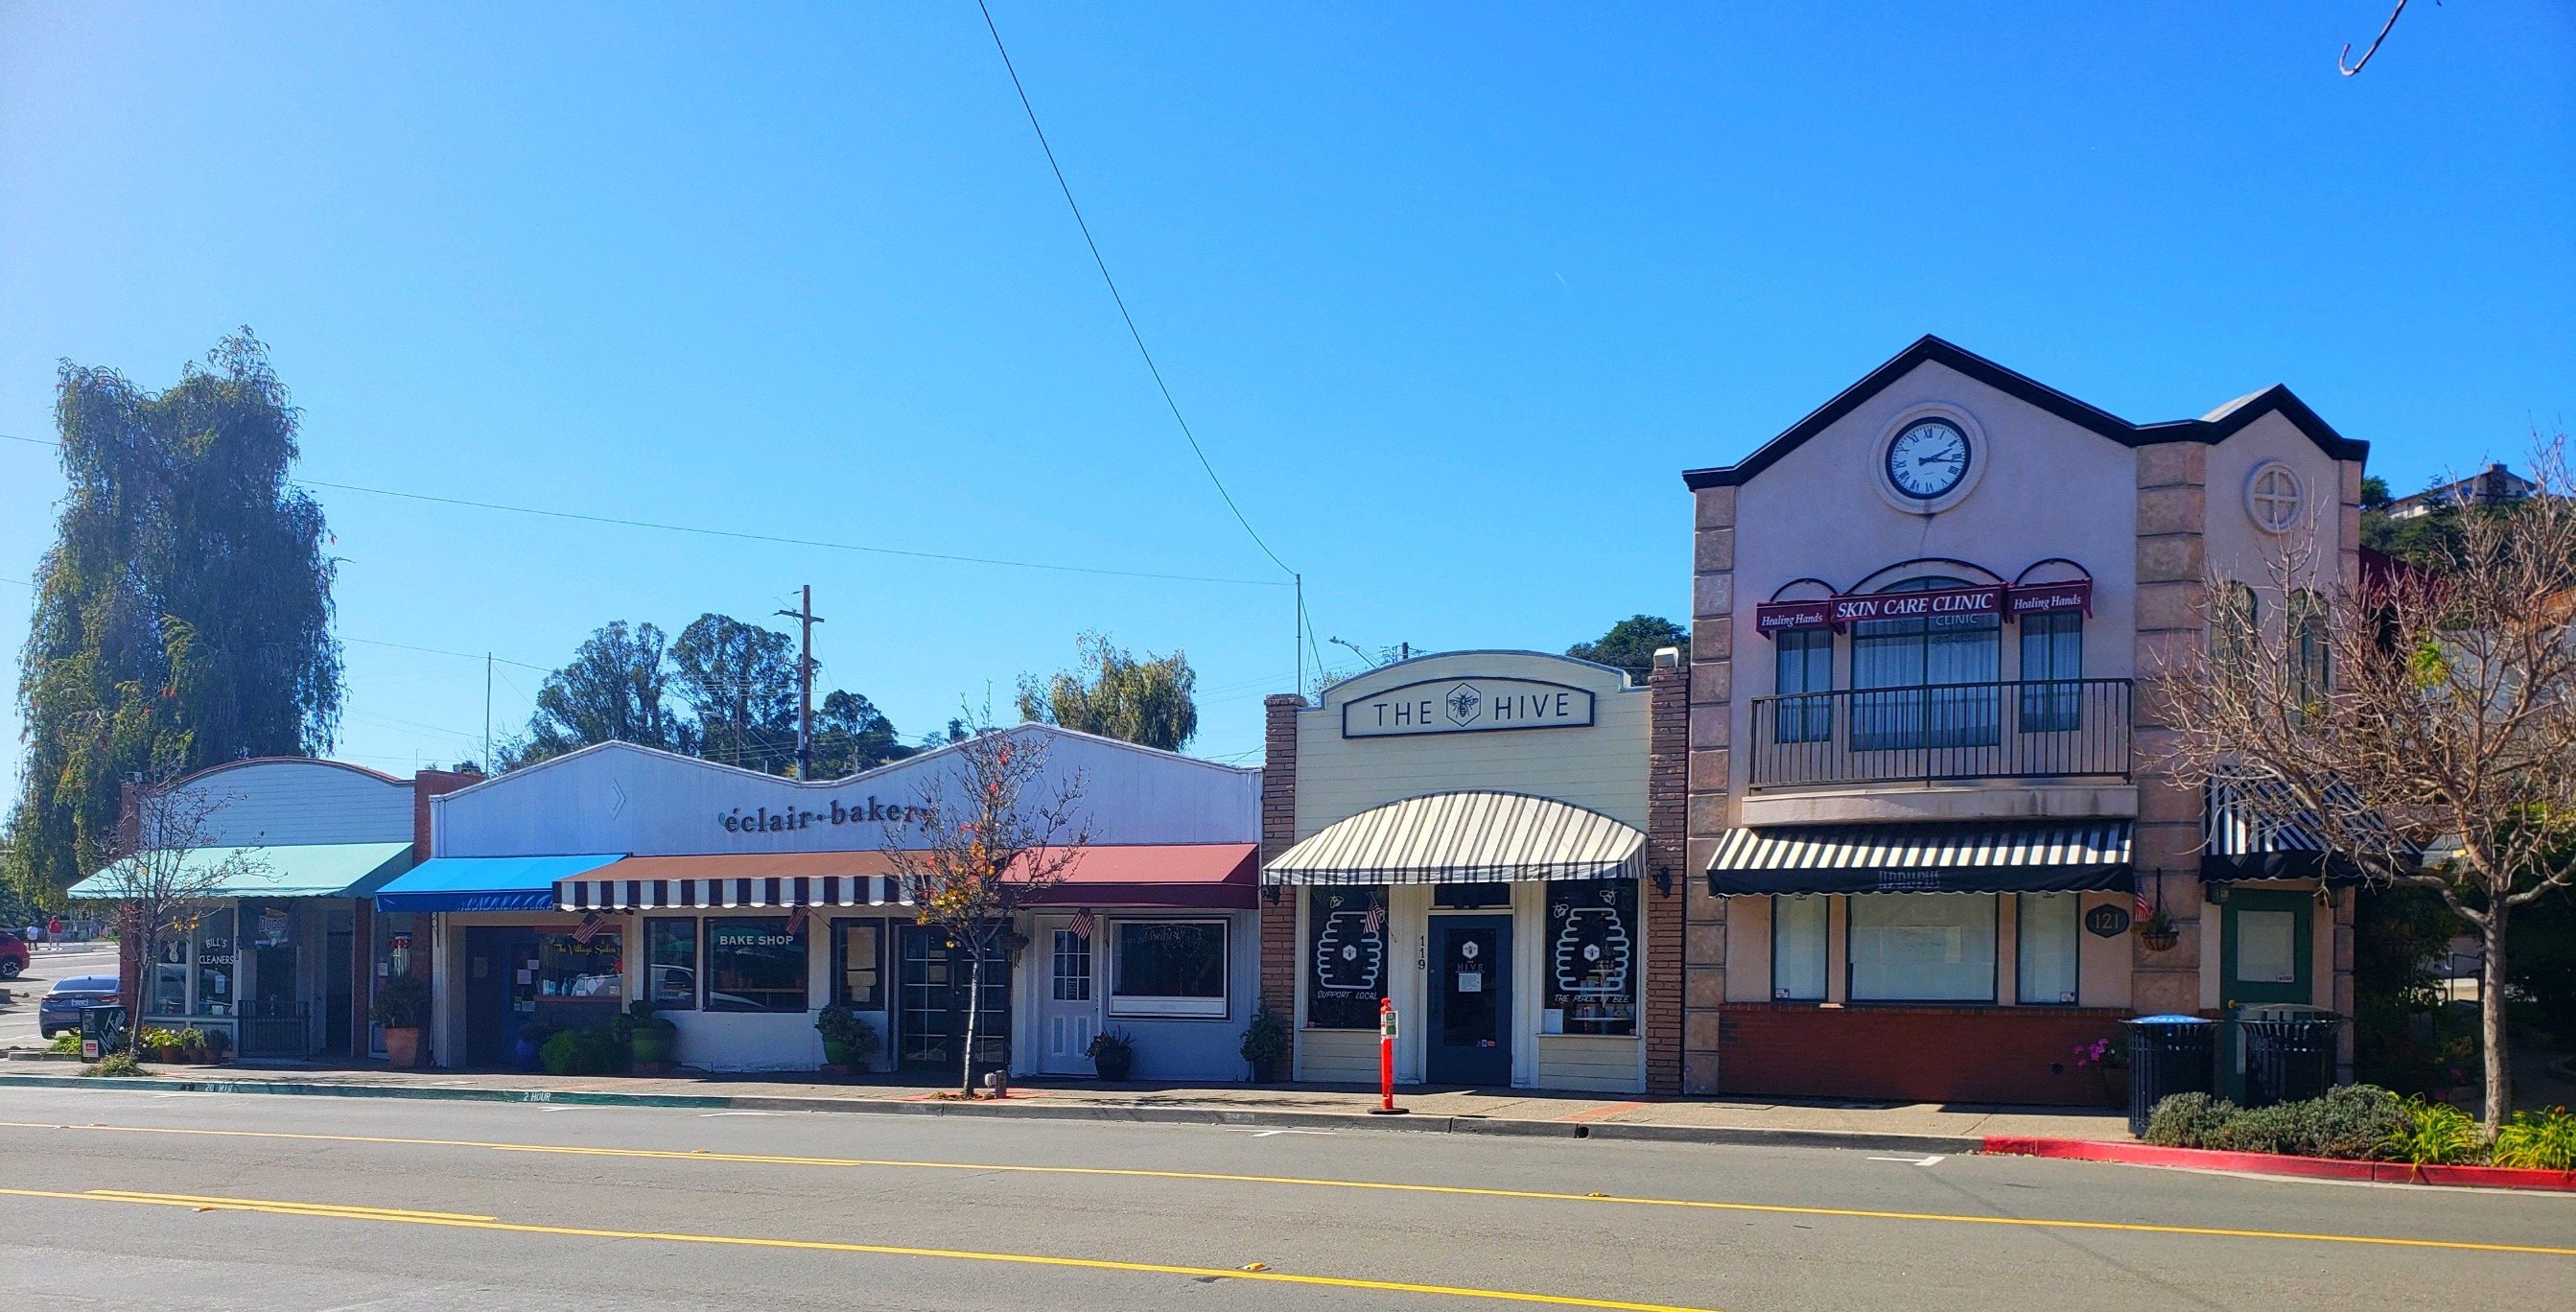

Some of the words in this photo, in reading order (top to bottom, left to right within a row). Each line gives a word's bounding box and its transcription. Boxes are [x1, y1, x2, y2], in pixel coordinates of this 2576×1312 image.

[1837, 600, 1879, 618] SKIN
[1884, 597, 1930, 615] CARE
[1932, 593, 1994, 613] CLINIC
[2014, 597, 2049, 611] Healing
[2050, 594, 2081, 607] Hands
[1762, 615, 1794, 628] Healing
[1795, 613, 1823, 624] Hands
[1935, 613, 1979, 626] CLINIC
[1373, 701, 1433, 727] THE
[1495, 692, 1569, 720] HIVE
[724, 806, 811, 833] éclair
[2096, 913, 2119, 929] 121
[205, 937, 227, 949] BILL'S
[719, 935, 755, 946] BAKE
[758, 935, 794, 946] SHOP
[552, 944, 566, 954] The
[568, 942, 593, 956] Village
[1417, 935, 1426, 971] 119
[199, 954, 235, 965] CLEANERS
[1457, 963, 1485, 972] HIVE
[1317, 990, 1352, 999] SUPPORT
[1355, 991, 1378, 1000] LOCAL
[1554, 994, 1570, 1003] THE
[1573, 994, 1596, 1003] PLACE
[1612, 994, 1630, 1003] BEE
[204, 1083, 215, 1092] 20
[219, 1084, 233, 1093] MIN
[523, 1091, 529, 1102] 2
[530, 1091, 551, 1102] HOUR
